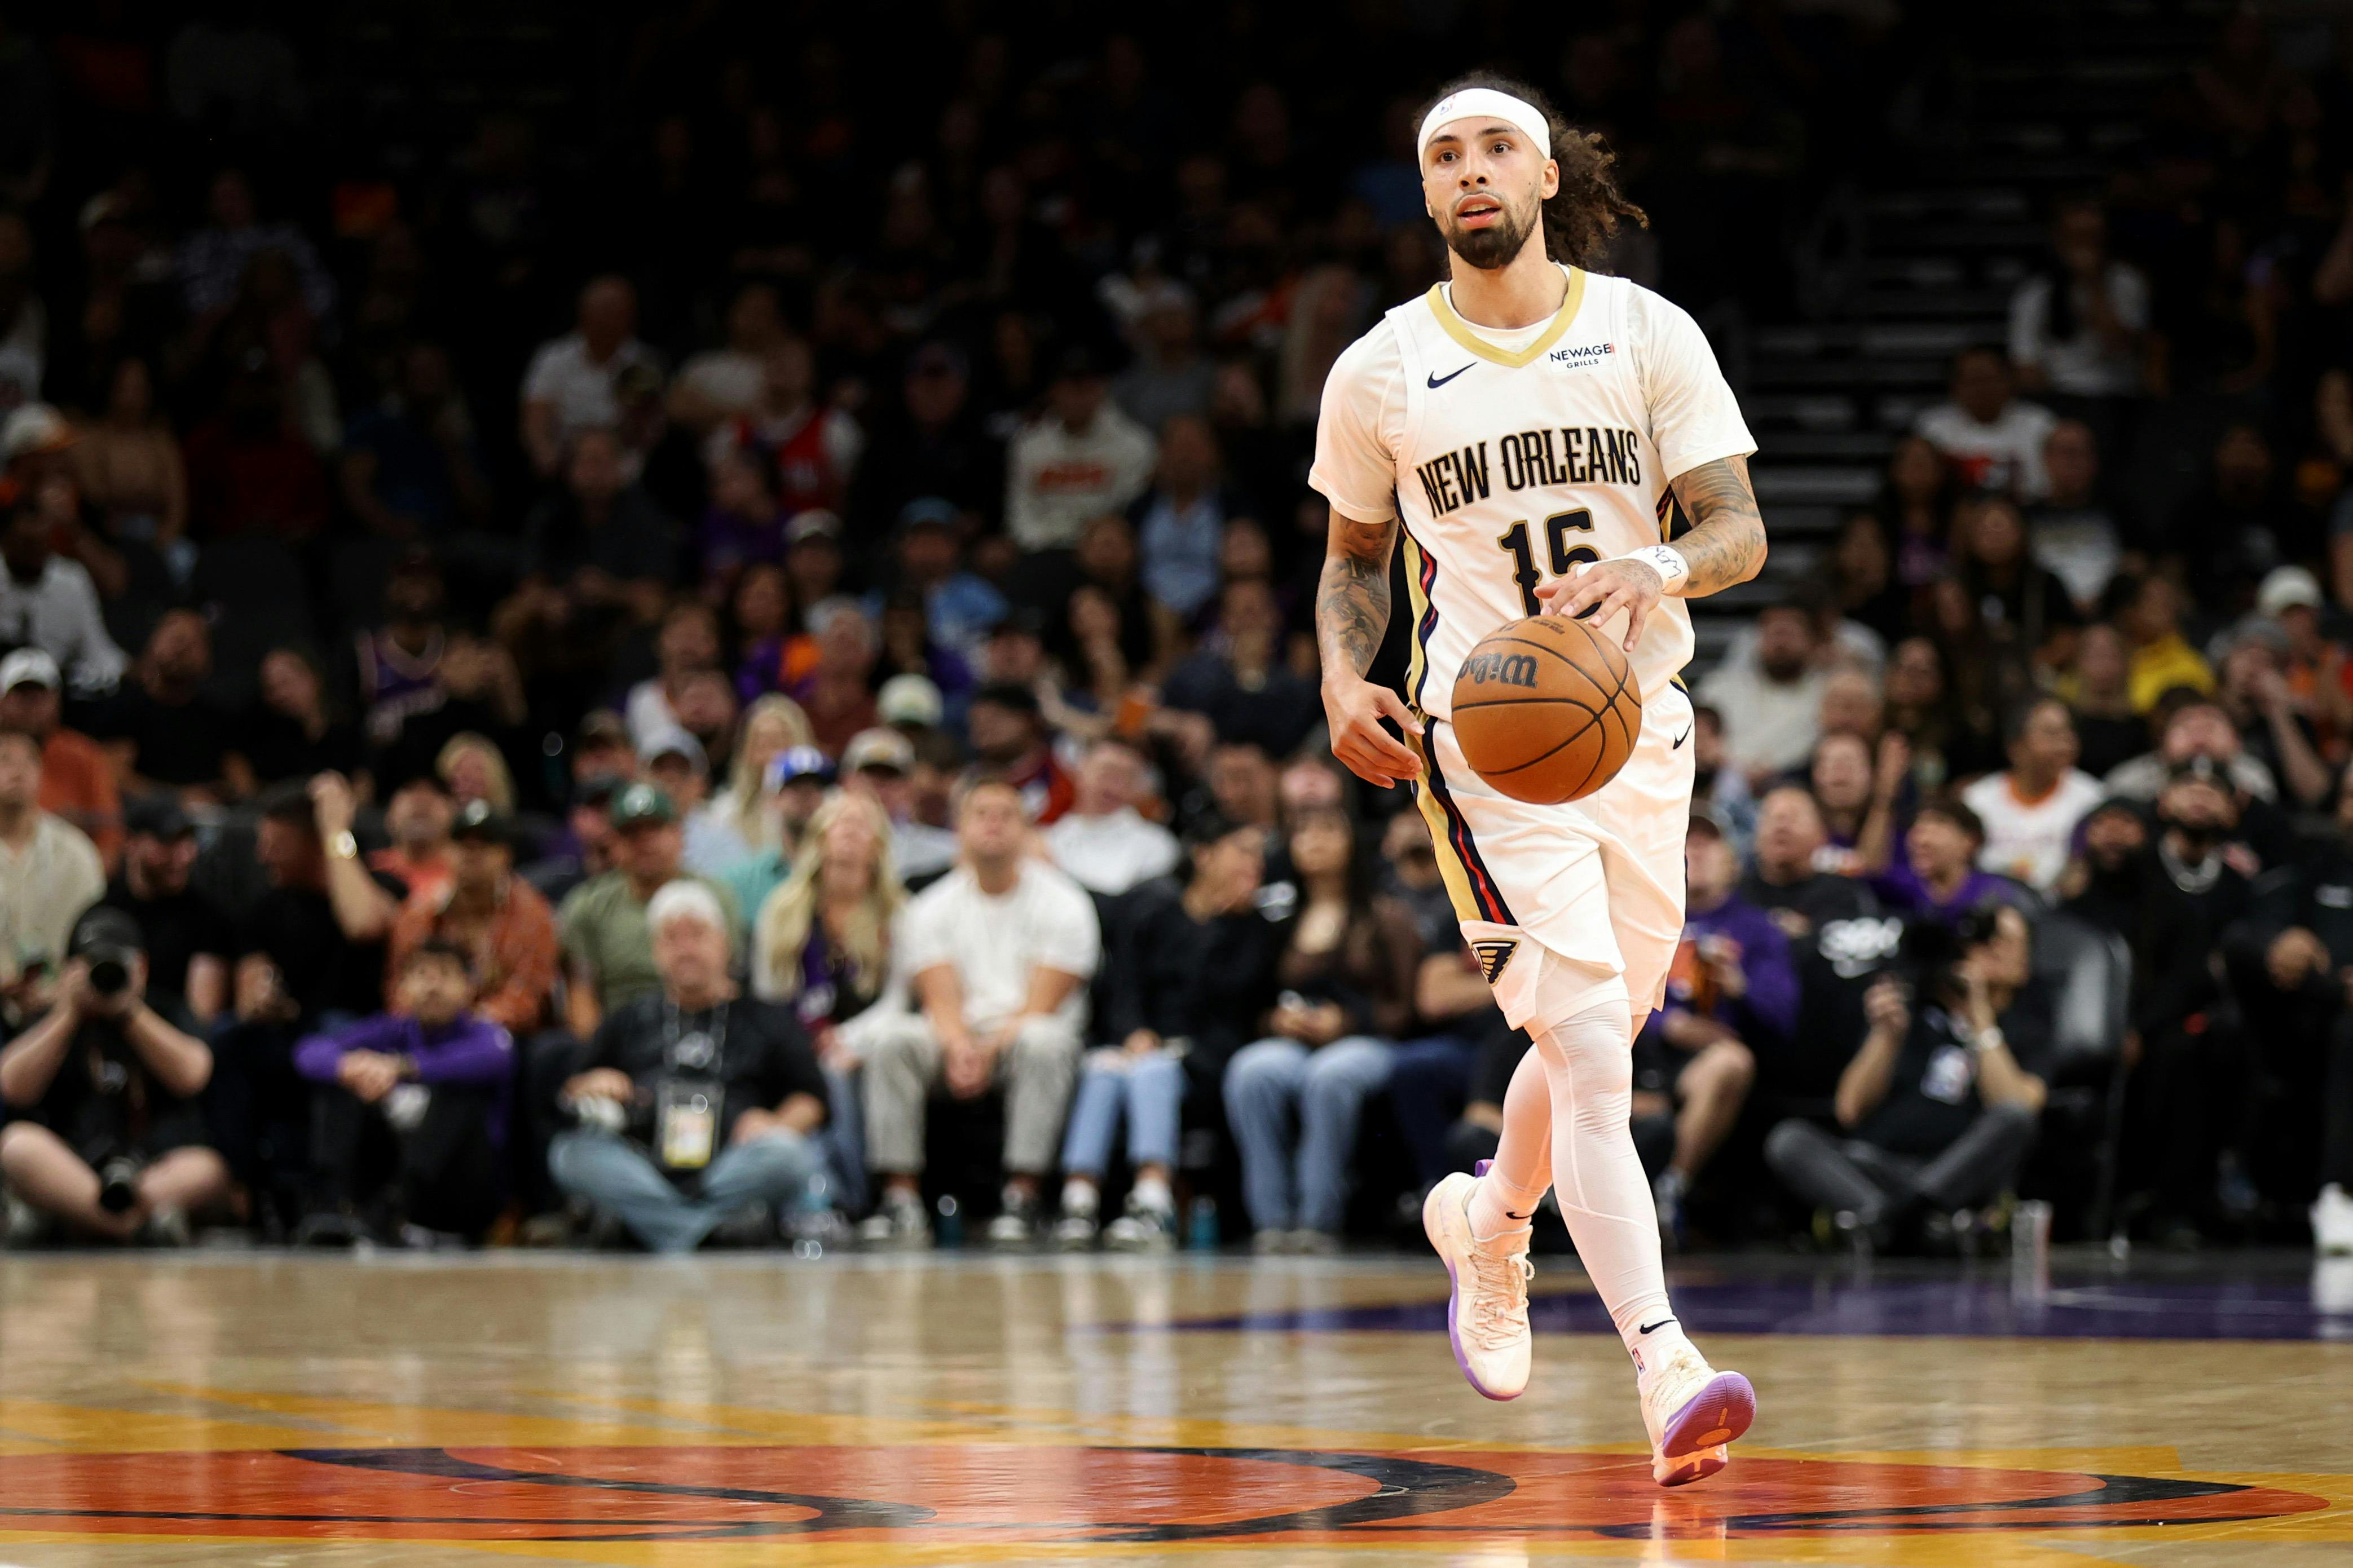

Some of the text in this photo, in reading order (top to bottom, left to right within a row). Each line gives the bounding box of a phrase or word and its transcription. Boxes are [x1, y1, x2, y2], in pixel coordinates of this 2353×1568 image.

[1550, 343, 1611, 362] NEWAGE
[1566, 359, 1599, 369] GRILLS
[1415, 427, 1641, 520] NEW ORLEANS
[1497, 507, 1602, 620] 15
